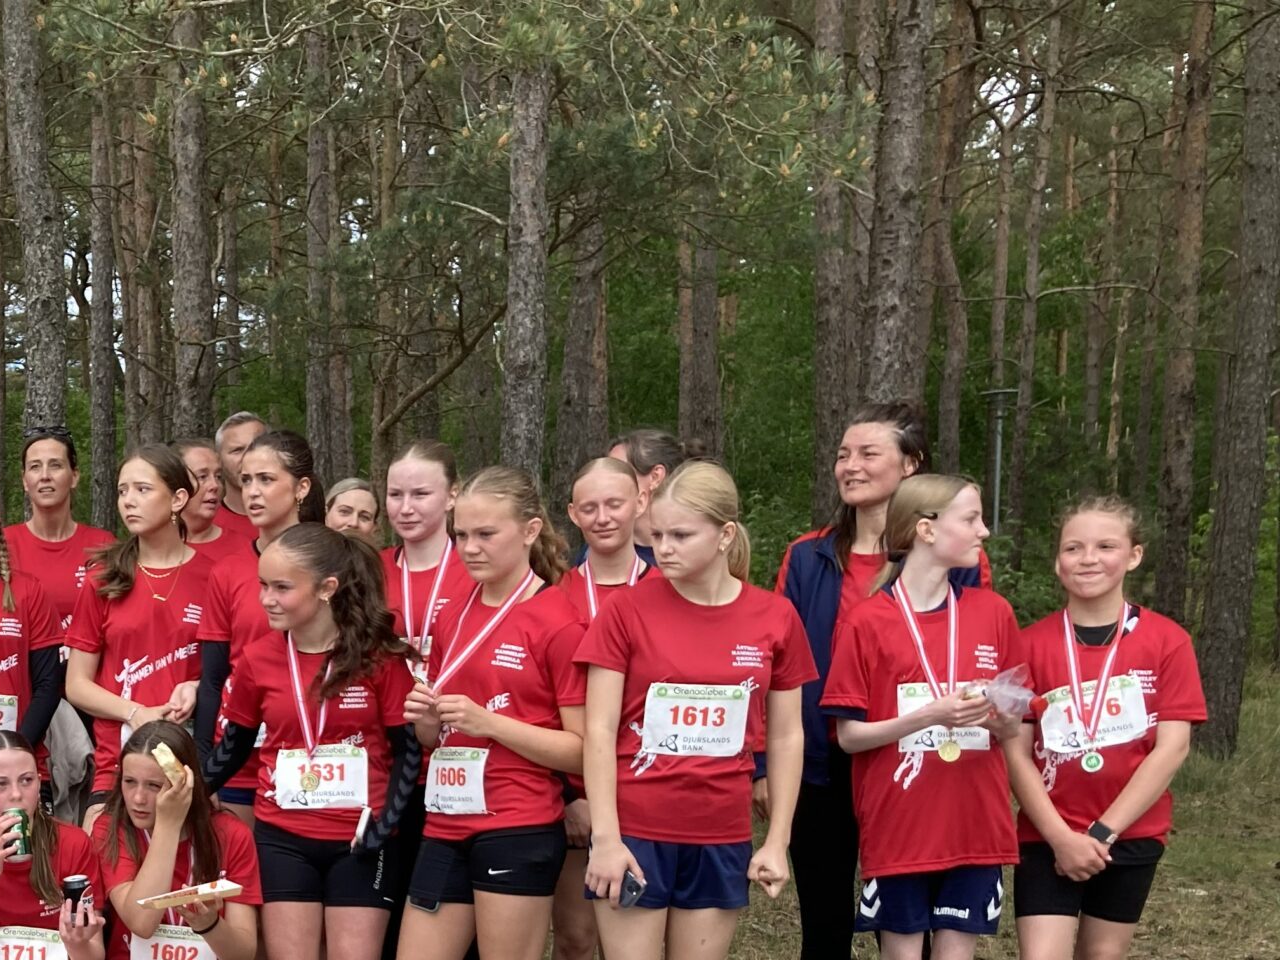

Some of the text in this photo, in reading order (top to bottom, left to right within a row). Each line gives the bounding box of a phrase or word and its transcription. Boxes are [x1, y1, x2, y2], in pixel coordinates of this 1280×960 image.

[174, 642, 199, 662] MERE
[669, 705, 727, 727] 1613
[682, 736, 731, 744] DJURSLANDS
[435, 767, 467, 786] 1606
